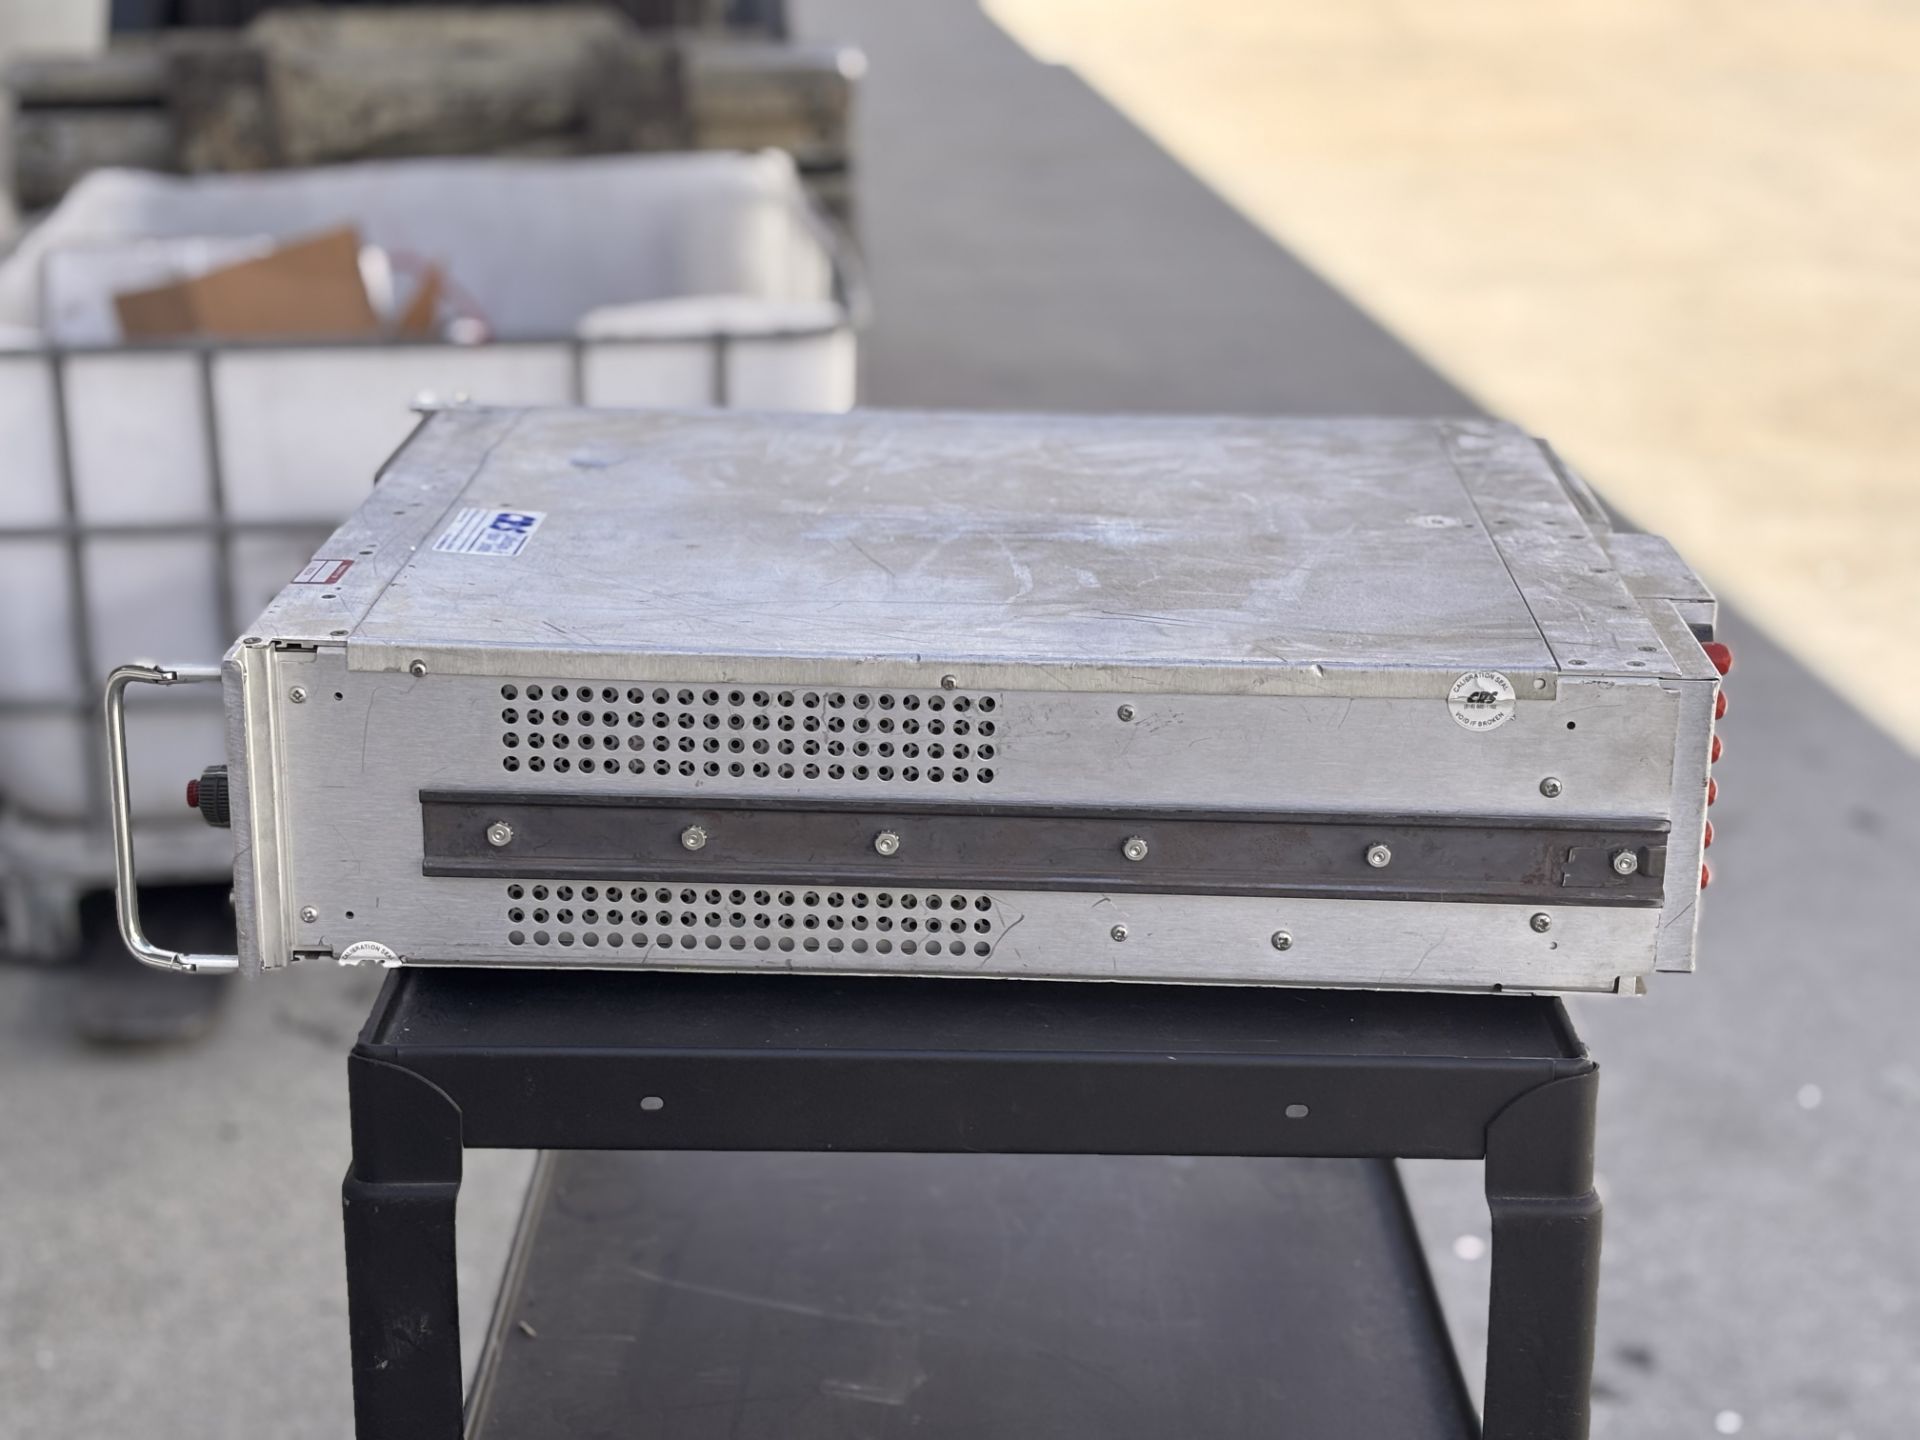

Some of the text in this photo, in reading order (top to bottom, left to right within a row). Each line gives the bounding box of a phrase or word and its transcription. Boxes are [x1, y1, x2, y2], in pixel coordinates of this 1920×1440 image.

[1453, 672, 1509, 693] CALIBRATION SEAL
[1455, 711, 1470, 724] VOID
[1477, 711, 1505, 727] BROKEN
[342, 944, 380, 960] CALIBRATION
